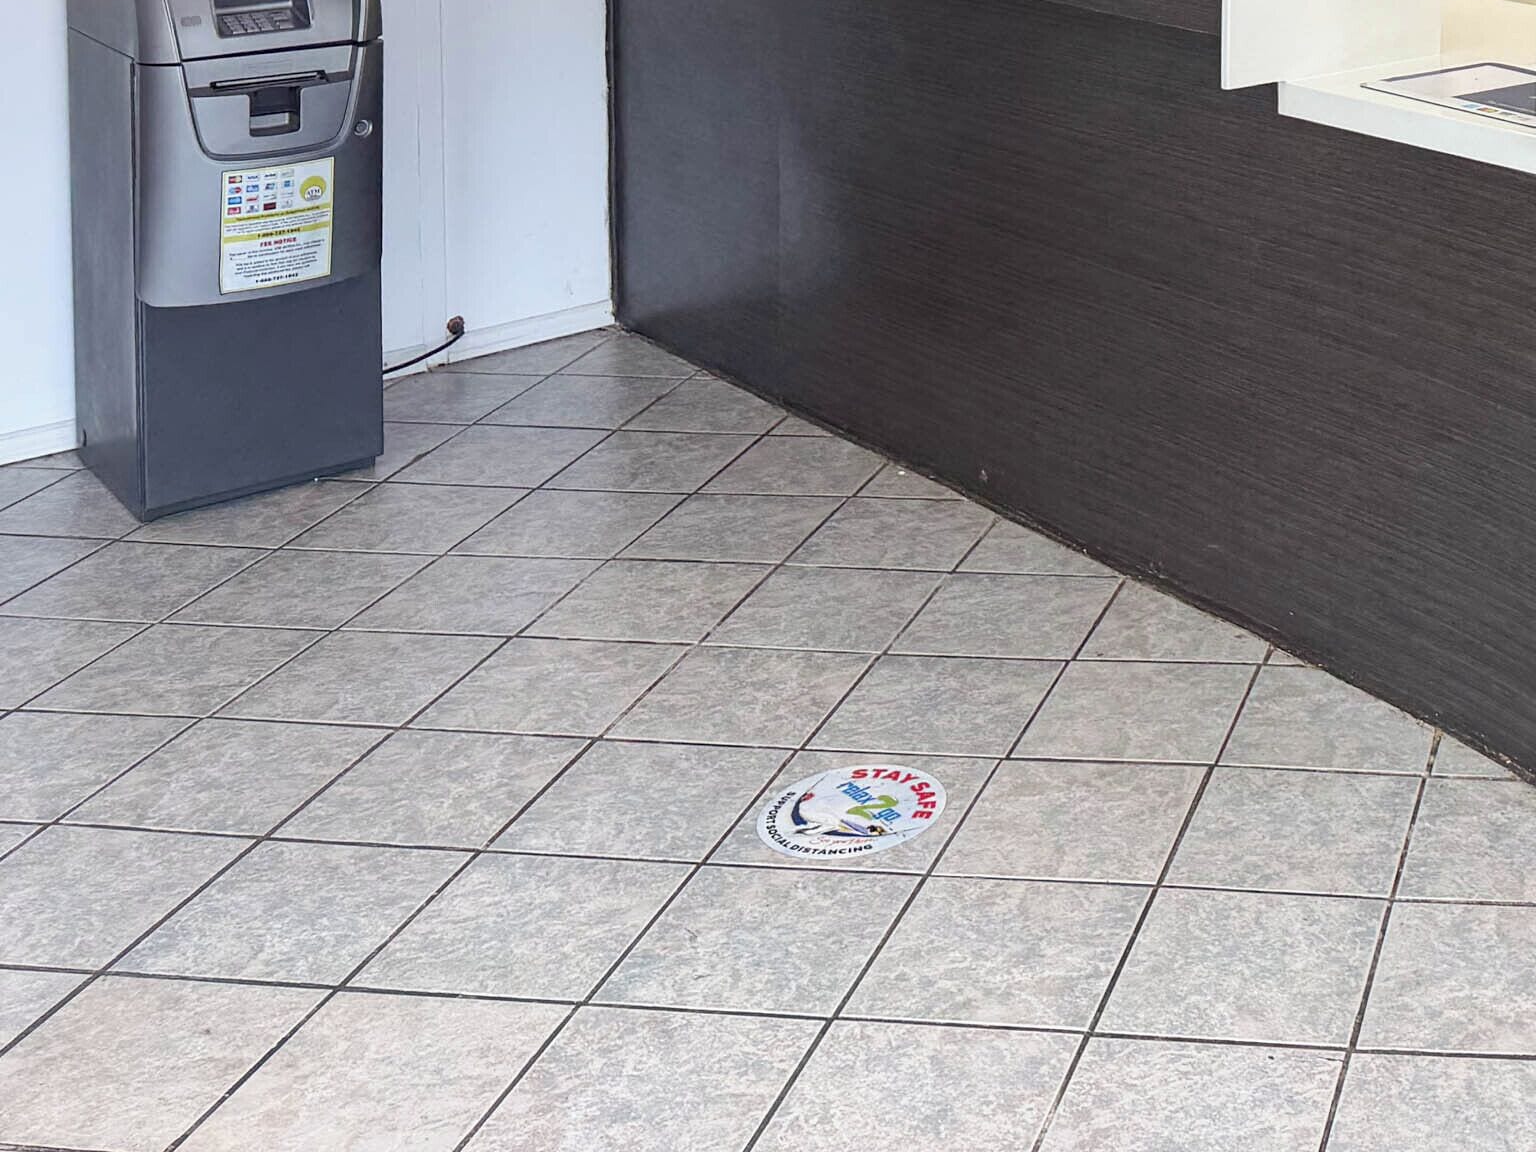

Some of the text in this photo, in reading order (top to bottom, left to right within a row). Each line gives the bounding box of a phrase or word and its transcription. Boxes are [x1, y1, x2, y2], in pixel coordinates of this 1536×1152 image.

[851, 769, 920, 784] STAY
[836, 781, 876, 805] relax
[910, 782, 936, 819] SAFE
[766, 791, 873, 855] SUPPORT SOCIAL DISTANCING
